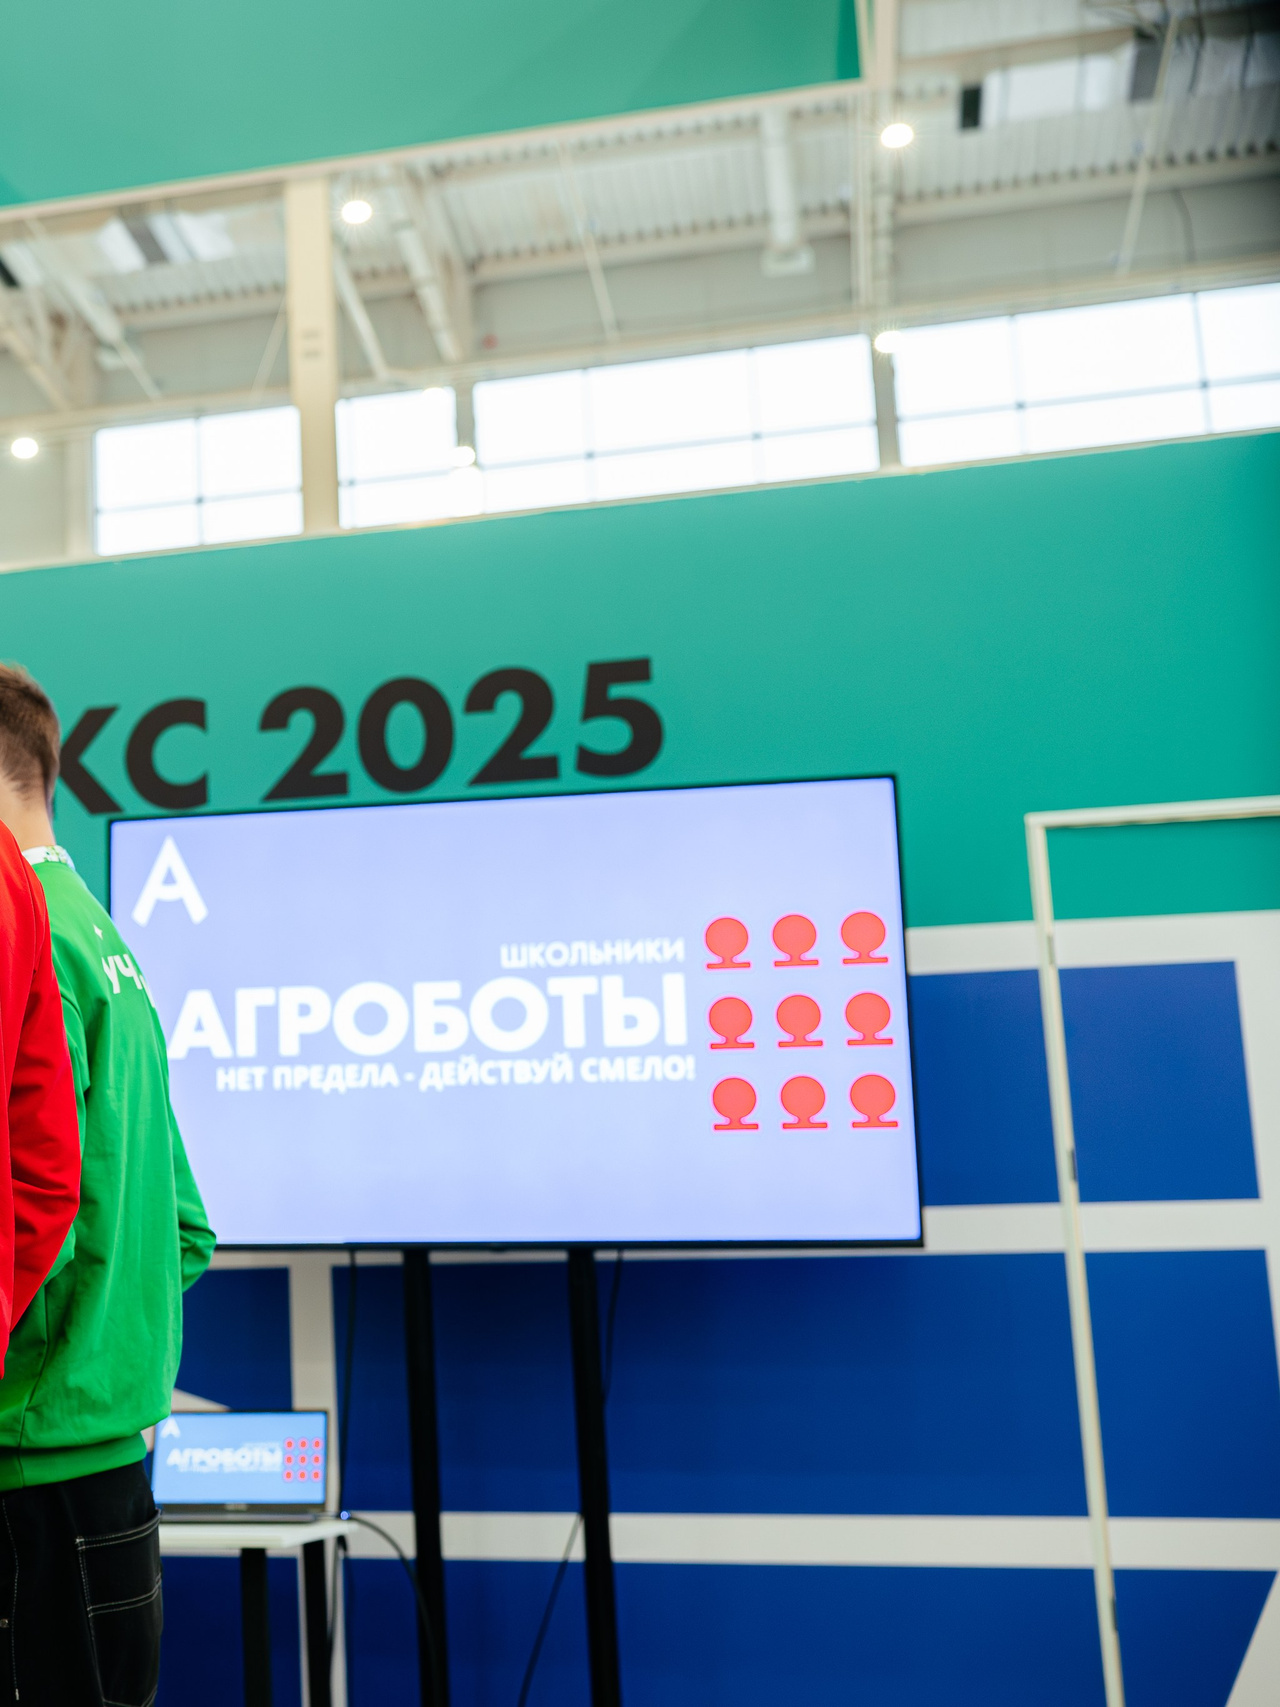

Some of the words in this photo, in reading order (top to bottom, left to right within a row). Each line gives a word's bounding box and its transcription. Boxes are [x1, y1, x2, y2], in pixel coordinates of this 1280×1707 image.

[258, 657, 663, 802] 2025
[500, 938, 685, 969] ШКОЛЬНИКИ
[167, 972, 688, 1060] АГРОБОТЫ
[216, 1065, 269, 1092] НЕТ
[273, 1062, 400, 1094] ПРЕДЕЛА
[418, 1053, 575, 1092] ДЕЙСТВУЙ
[579, 1054, 696, 1083] СМЕЛО!
[166, 1446, 283, 1468] АГРОБОТЫ
